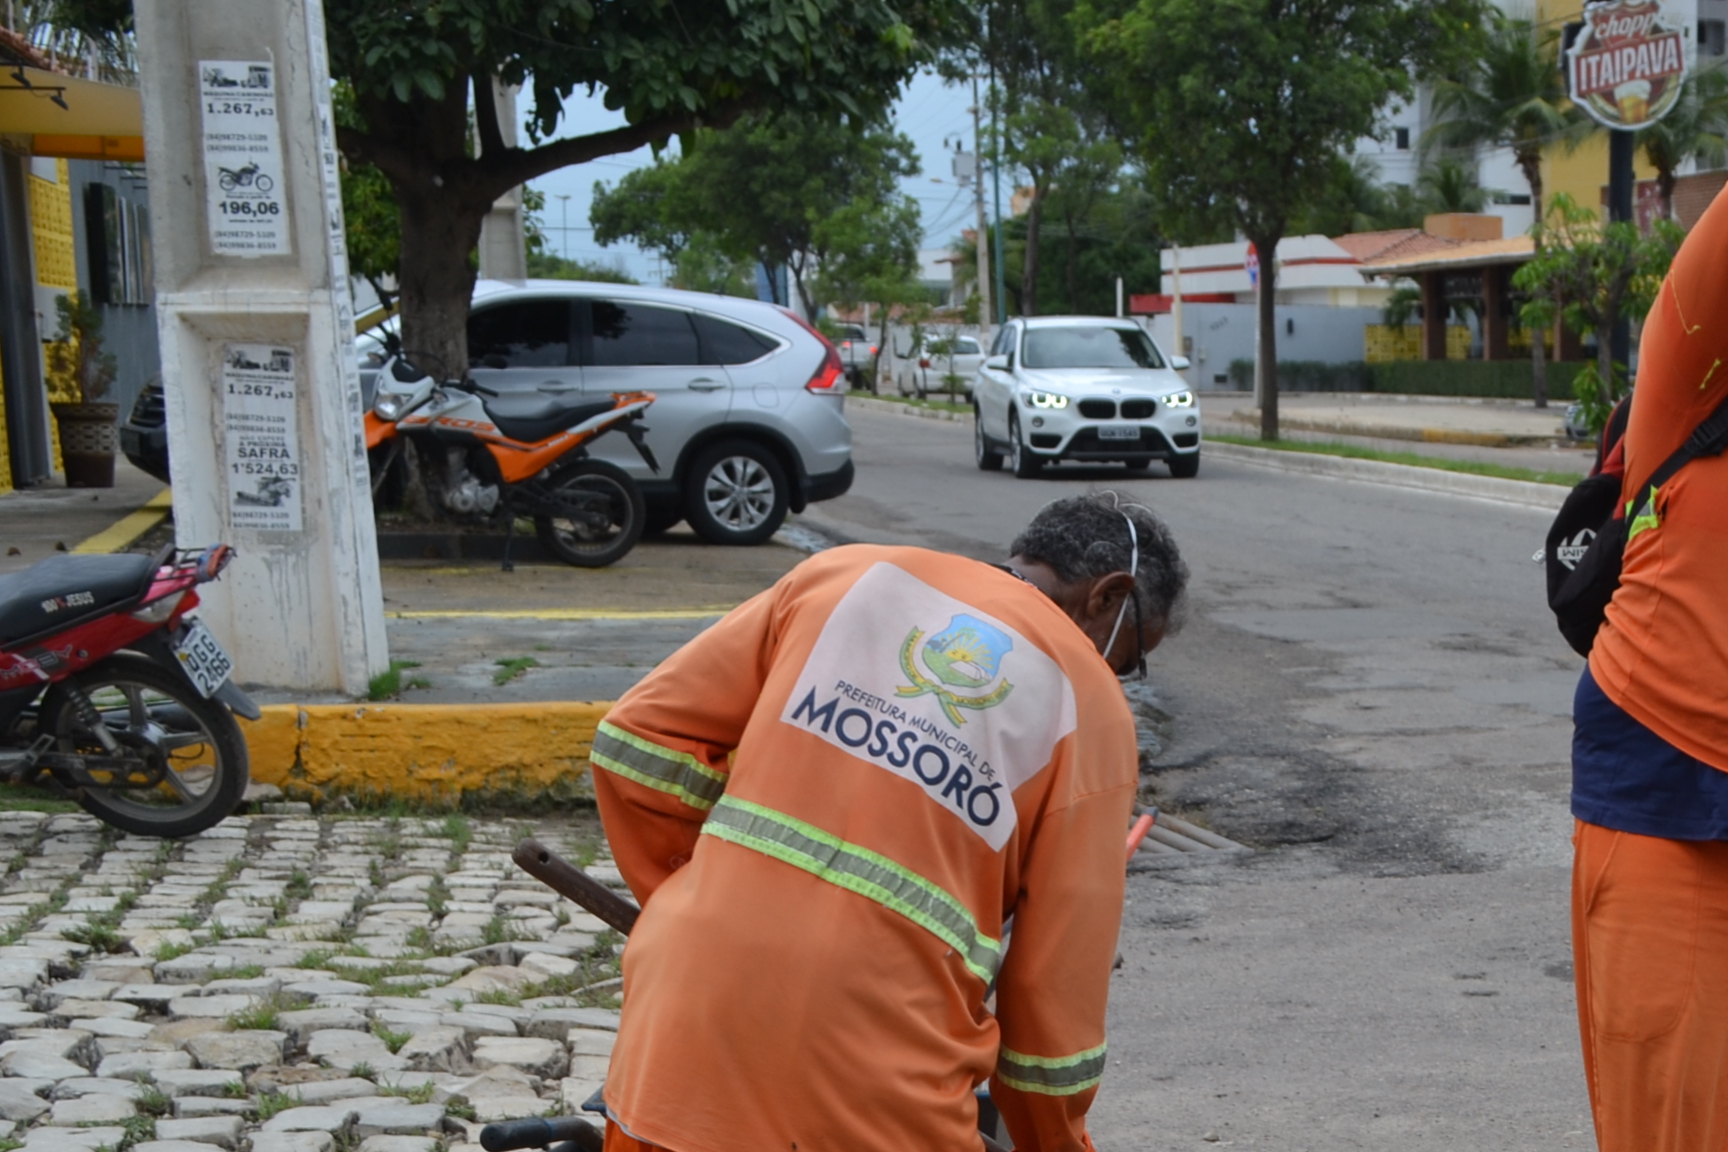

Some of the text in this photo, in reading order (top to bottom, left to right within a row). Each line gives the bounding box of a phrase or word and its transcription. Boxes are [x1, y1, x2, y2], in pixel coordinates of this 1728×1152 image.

[1594, 12, 1657, 39] chopp
[1580, 37, 1680, 91] ITAIPAVA
[207, 102, 274, 117] 1.267,63
[218, 201, 280, 217] 196,06
[228, 383, 294, 400] 1.267,63
[237, 447, 291, 459] SAFRA
[66, 590, 95, 607] JESUS
[834, 680, 907, 724] PREFEITURA
[908, 715, 977, 768] MUNICIPAL
[978, 761, 996, 782] DE
[791, 685, 1003, 827] MOSSORÓ
